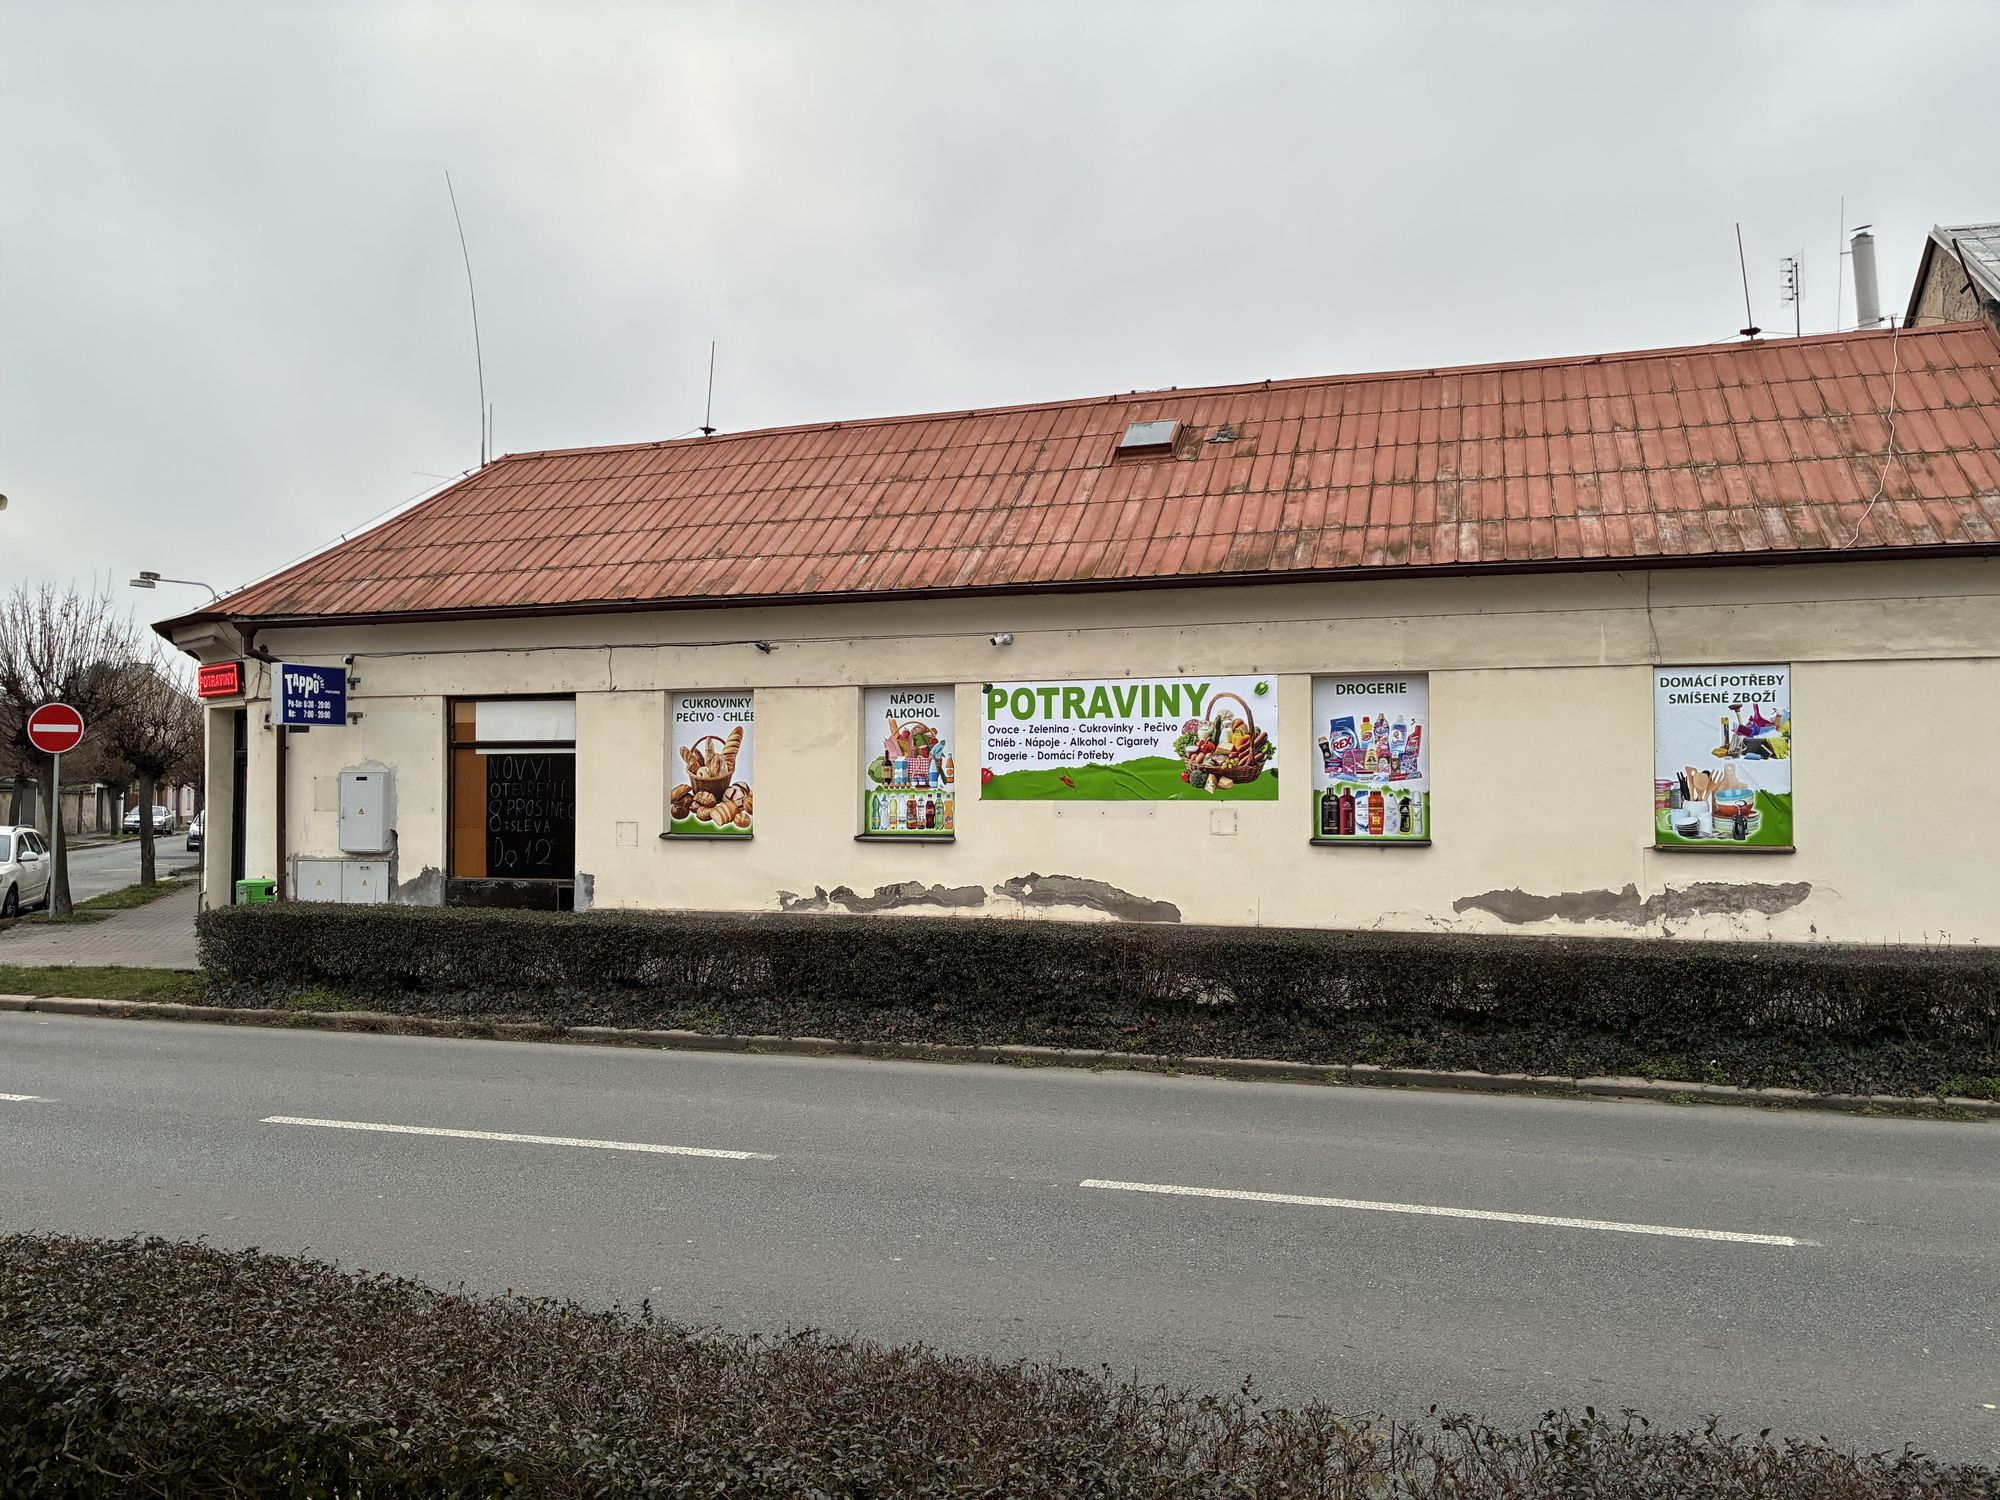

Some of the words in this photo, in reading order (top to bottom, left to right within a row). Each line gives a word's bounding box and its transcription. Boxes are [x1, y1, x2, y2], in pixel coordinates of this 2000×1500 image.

[200, 672, 234, 688] POTRAVINY
[1660, 674, 1717, 688] DOMÁCÍ
[1720, 673, 1785, 687] POTŘEBY
[1336, 682, 1407, 695] DROGERIE
[682, 697, 752, 709] CUKROVINKY
[890, 692, 935, 705] NÁPOJE
[987, 683, 1210, 721] POTRAVINY
[1668, 691, 1729, 704] SMÍŠENÉ
[1733, 689, 1776, 703] ZBOŽÍ
[676, 711, 714, 722] PEČIVO
[885, 707, 940, 719] ALKOHOL
[988, 725, 1020, 735] Ovoce
[1029, 724, 1069, 734] Zelenina
[1079, 723, 1134, 735] Cukrovinky
[1144, 721, 1178, 732] Pečivo
[988, 737, 1016, 748] Chléb
[1025, 737, 1060, 749] Nápoje
[1070, 736, 1107, 747] Alkohol
[1116, 736, 1159, 748] Cigarety
[1332, 736, 1353, 751] REX
[988, 750, 1028, 762] Drogerie
[1037, 750, 1075, 760] Domácí
[1077, 749, 1115, 762] Potřeby
